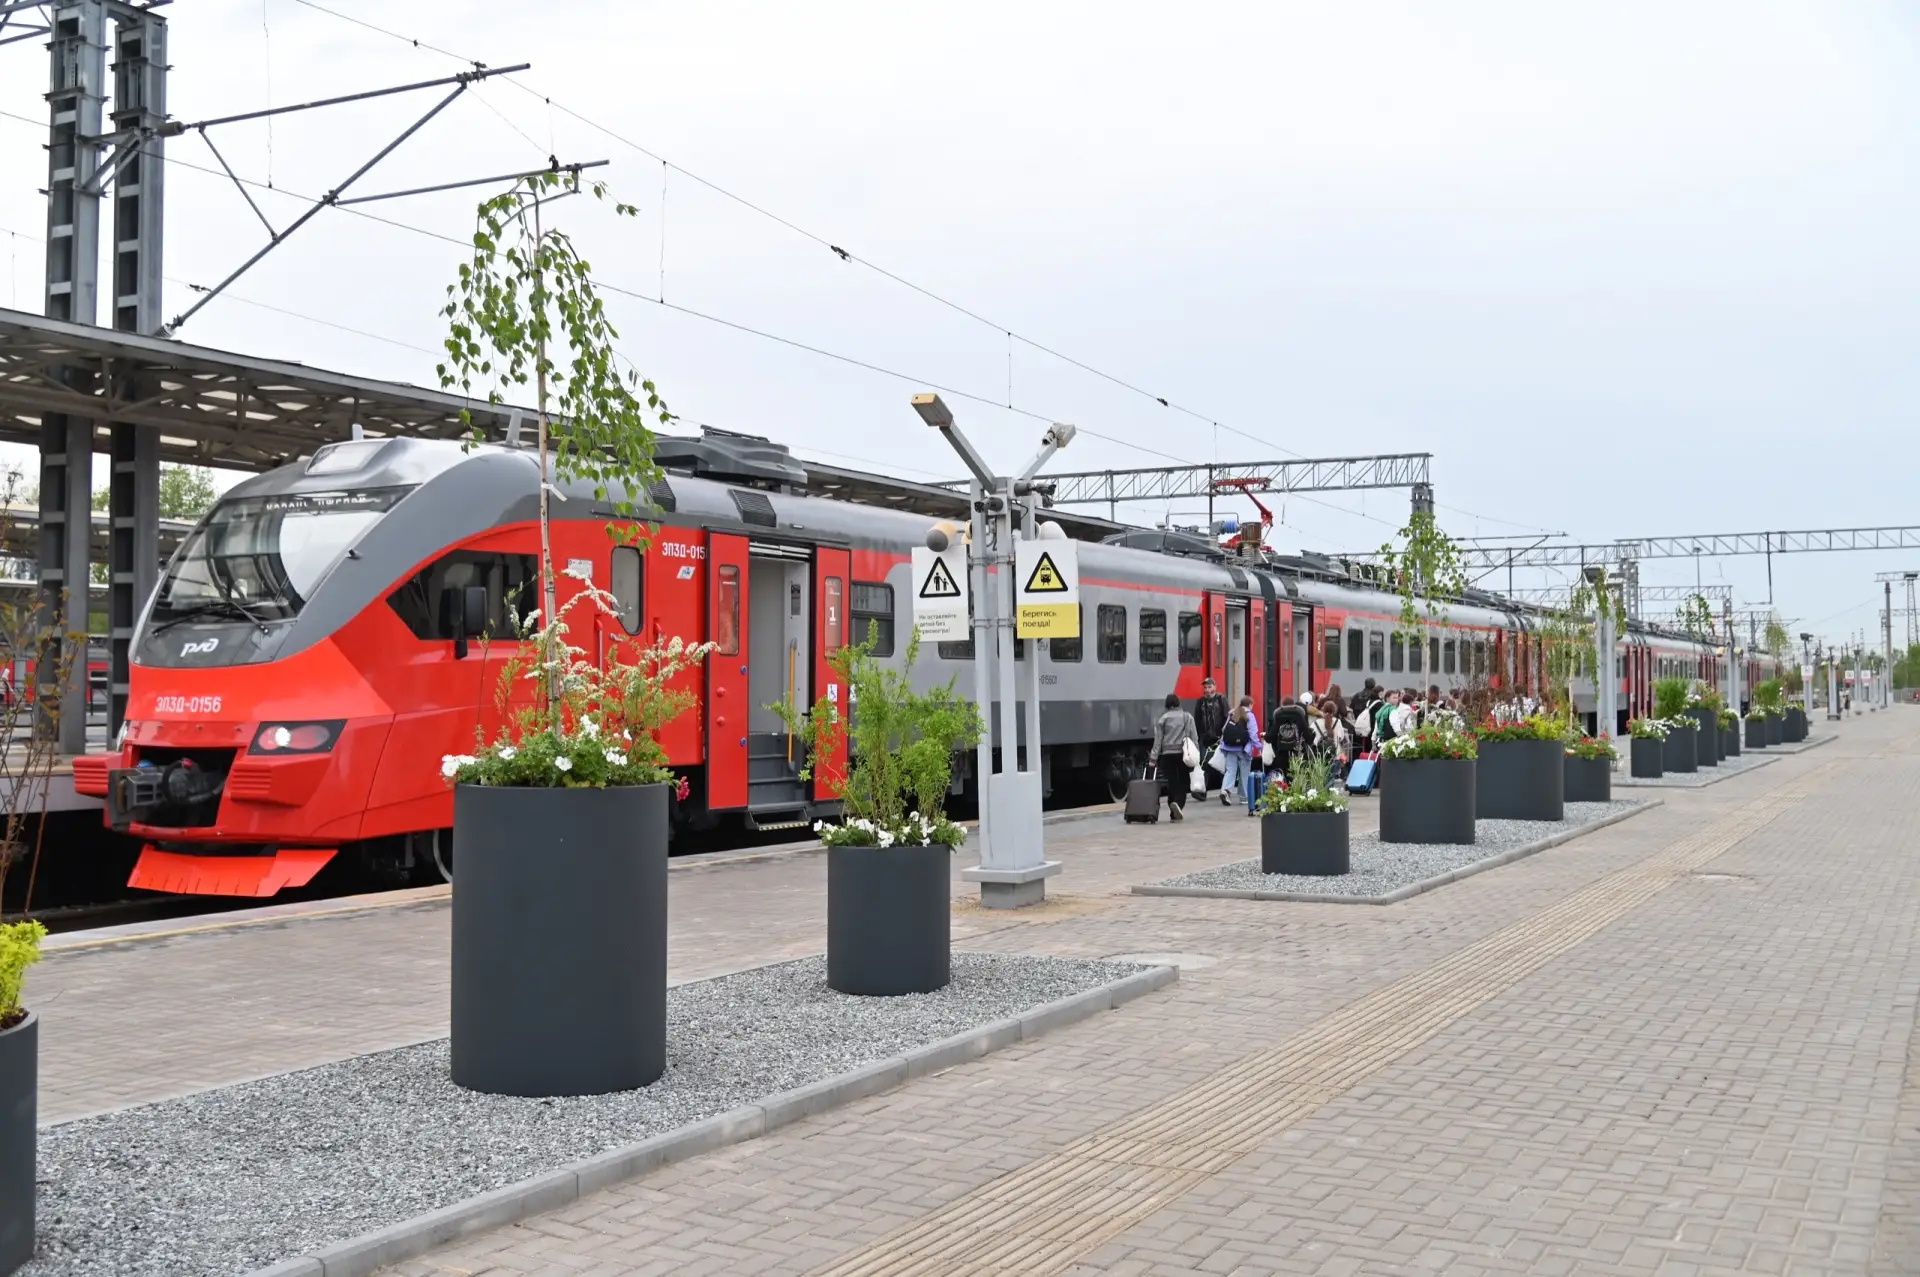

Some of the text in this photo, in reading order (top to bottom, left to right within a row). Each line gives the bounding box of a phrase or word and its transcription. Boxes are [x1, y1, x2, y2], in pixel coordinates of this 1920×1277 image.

[662, 541, 706, 560] ЭП3Д-015
[829, 606, 837, 621] 1
[1022, 610, 1057, 618] Берегись
[1022, 619, 1051, 628] поезда!
[919, 626, 951, 635] рисмотра!
[155, 696, 222, 713] ЭП3Д-0156
